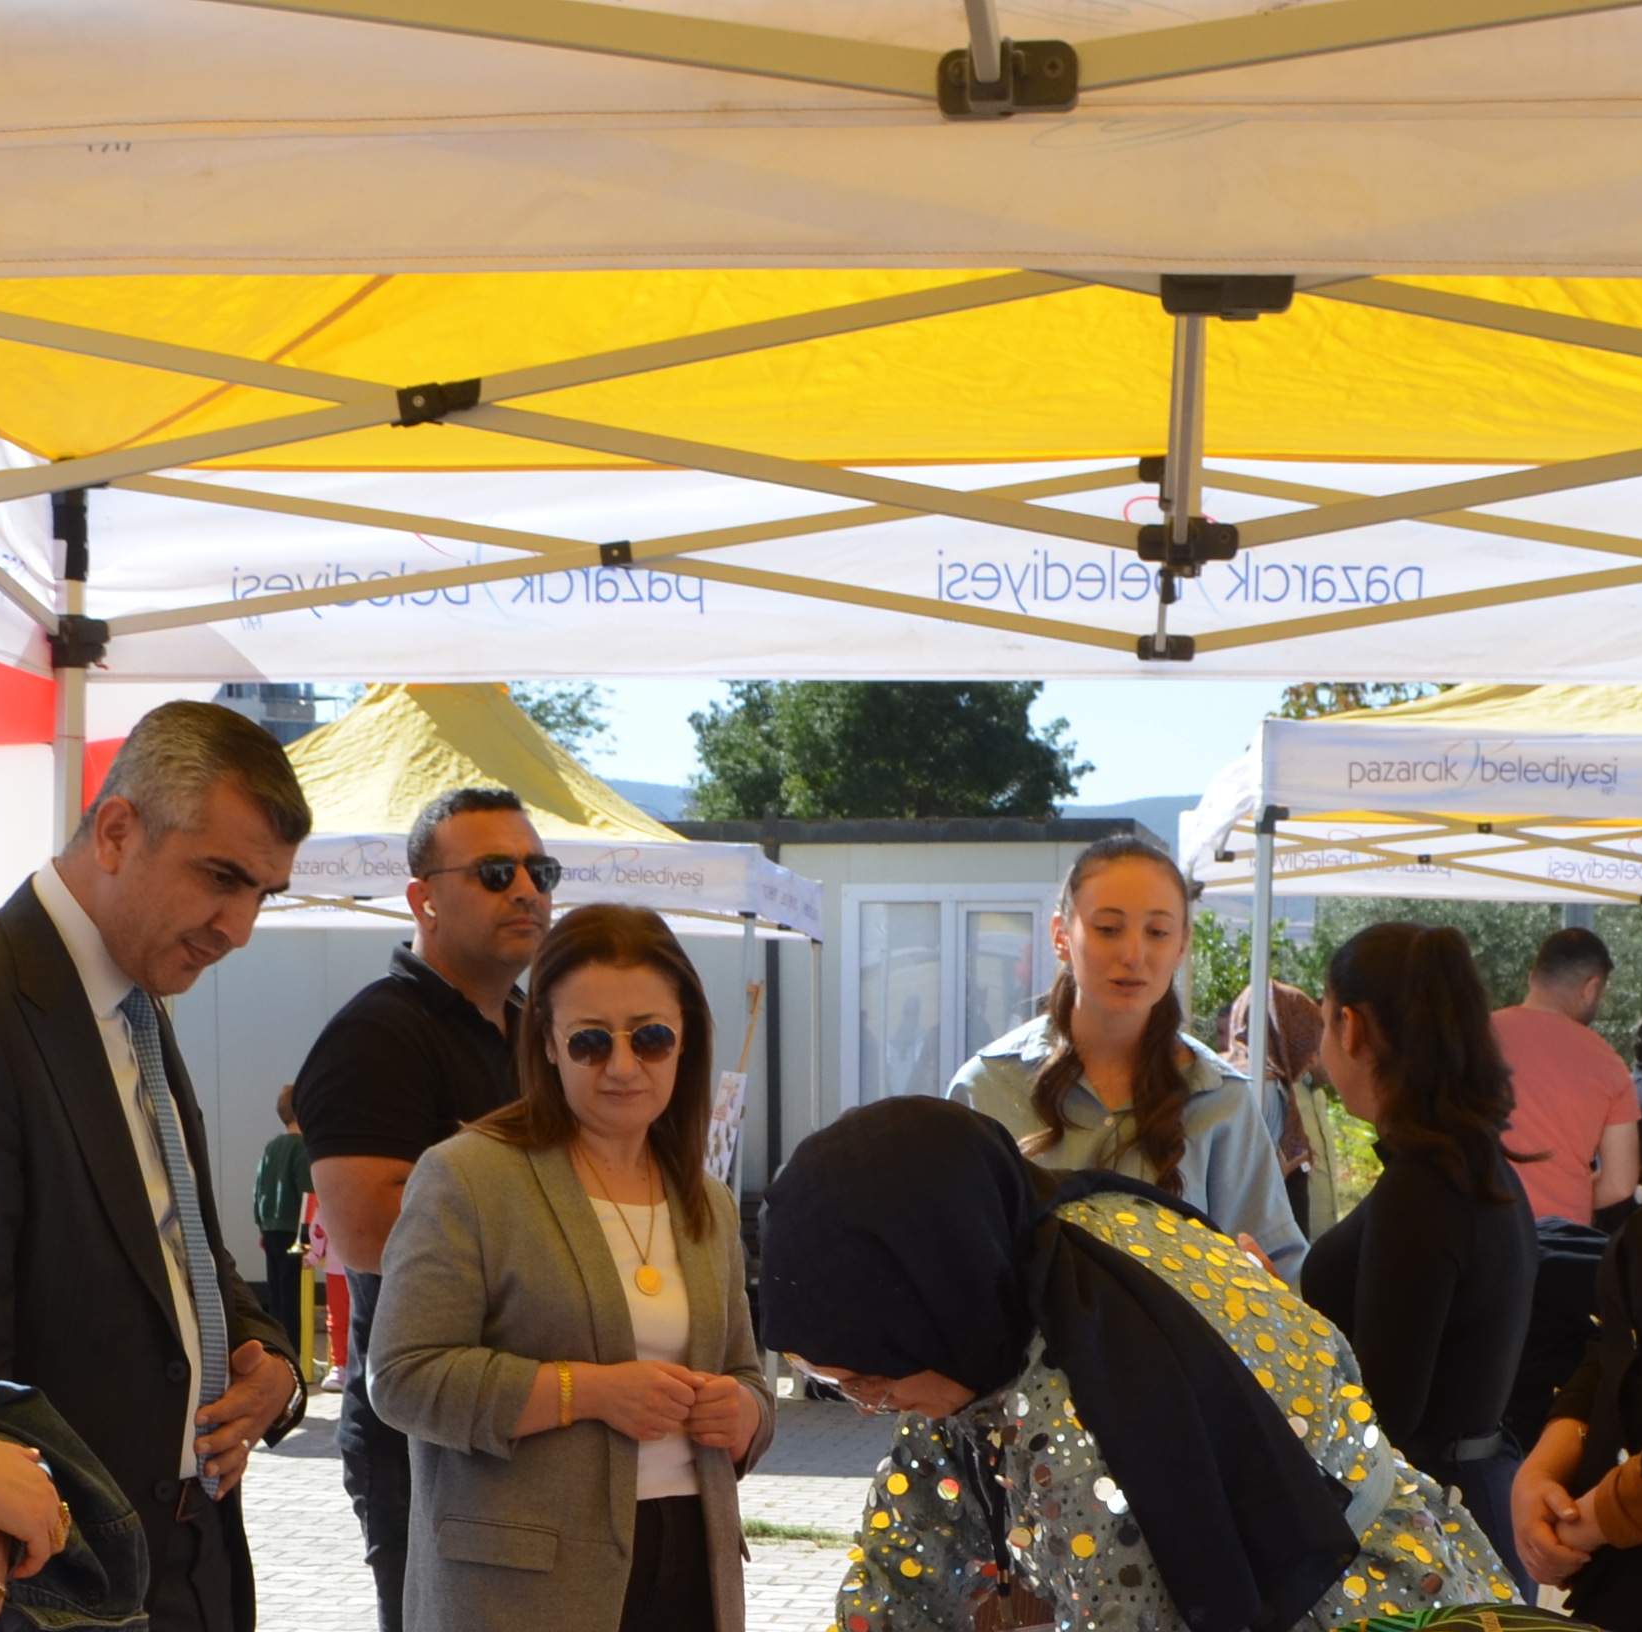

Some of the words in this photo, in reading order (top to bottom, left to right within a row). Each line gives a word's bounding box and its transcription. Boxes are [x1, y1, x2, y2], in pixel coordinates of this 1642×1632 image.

[1348, 755, 1459, 790] pazarcık
[1480, 755, 1619, 790] belediyesi
[292, 857, 350, 876] azarcık
[615, 865, 706, 890] belediyesi
